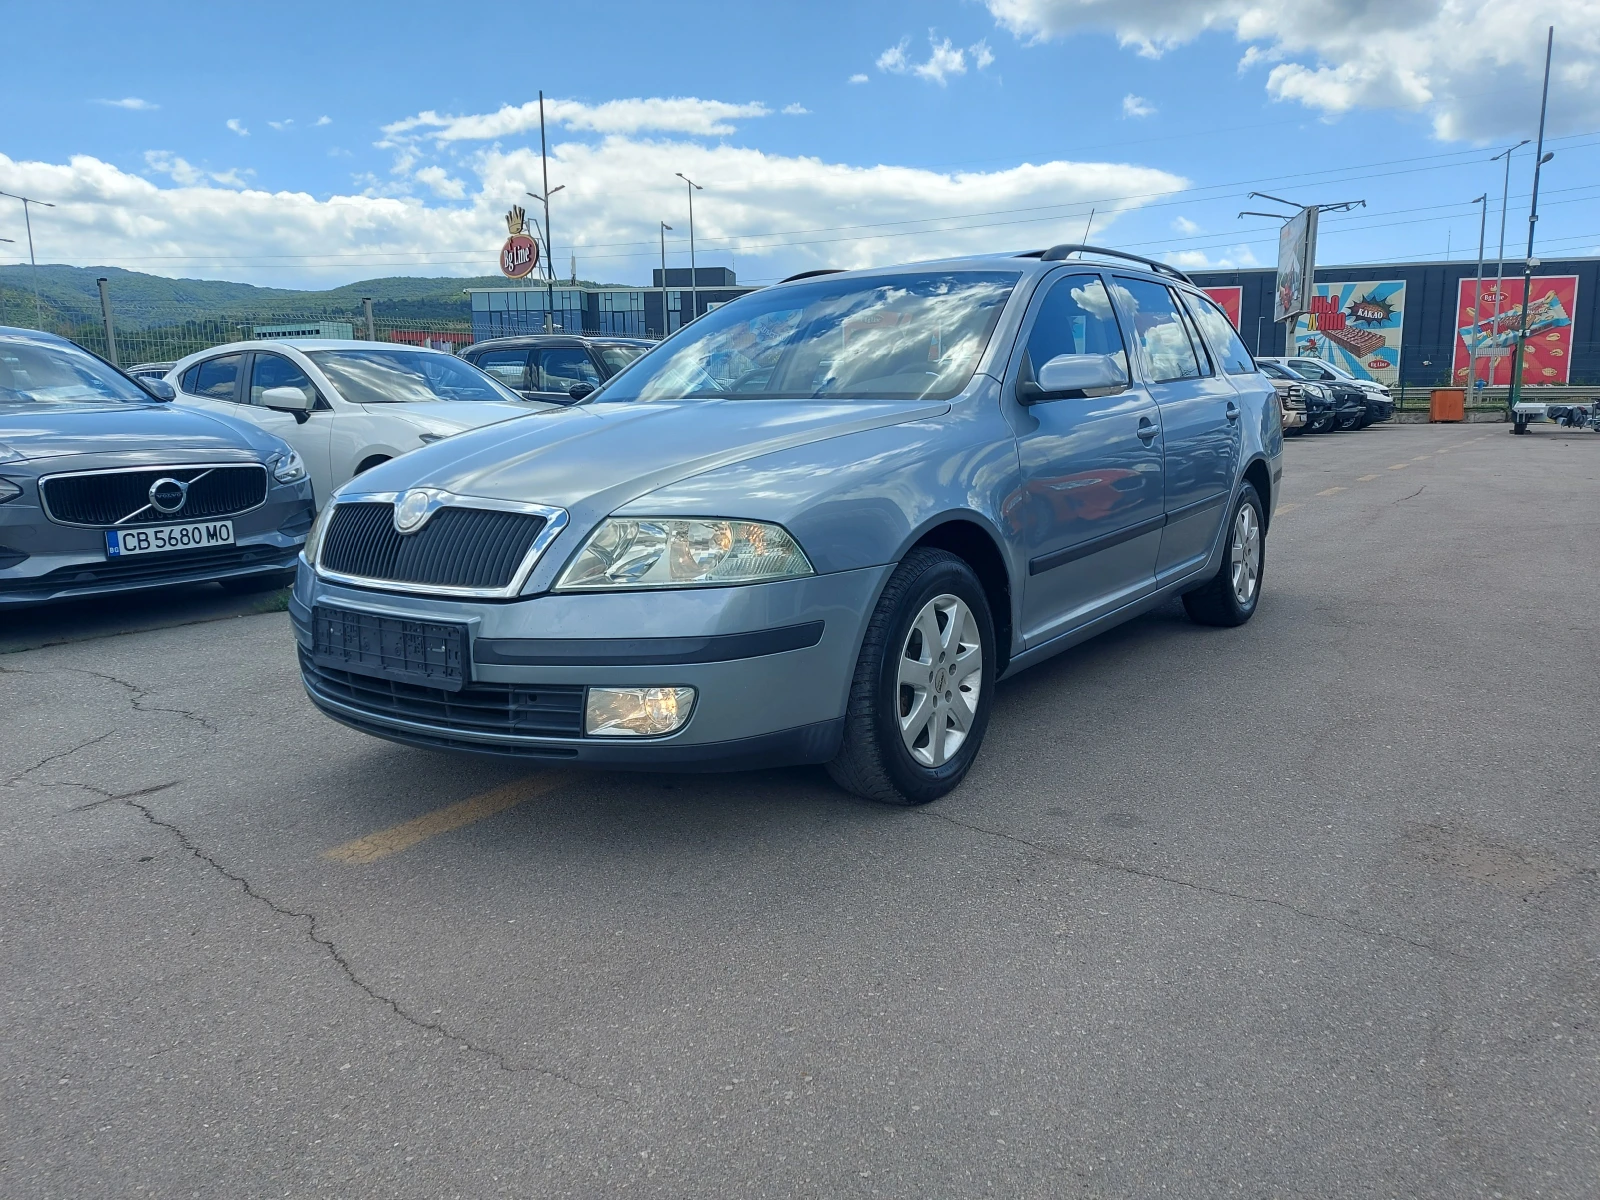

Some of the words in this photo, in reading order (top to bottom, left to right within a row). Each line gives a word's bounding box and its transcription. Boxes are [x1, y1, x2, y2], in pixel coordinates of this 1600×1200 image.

[503, 250, 514, 271] Bg
[514, 245, 529, 265] Line
[1357, 309, 1383, 318] КАКАО
[122, 531, 151, 552] CB
[153, 526, 203, 549] 5680
[205, 524, 231, 544] MO
